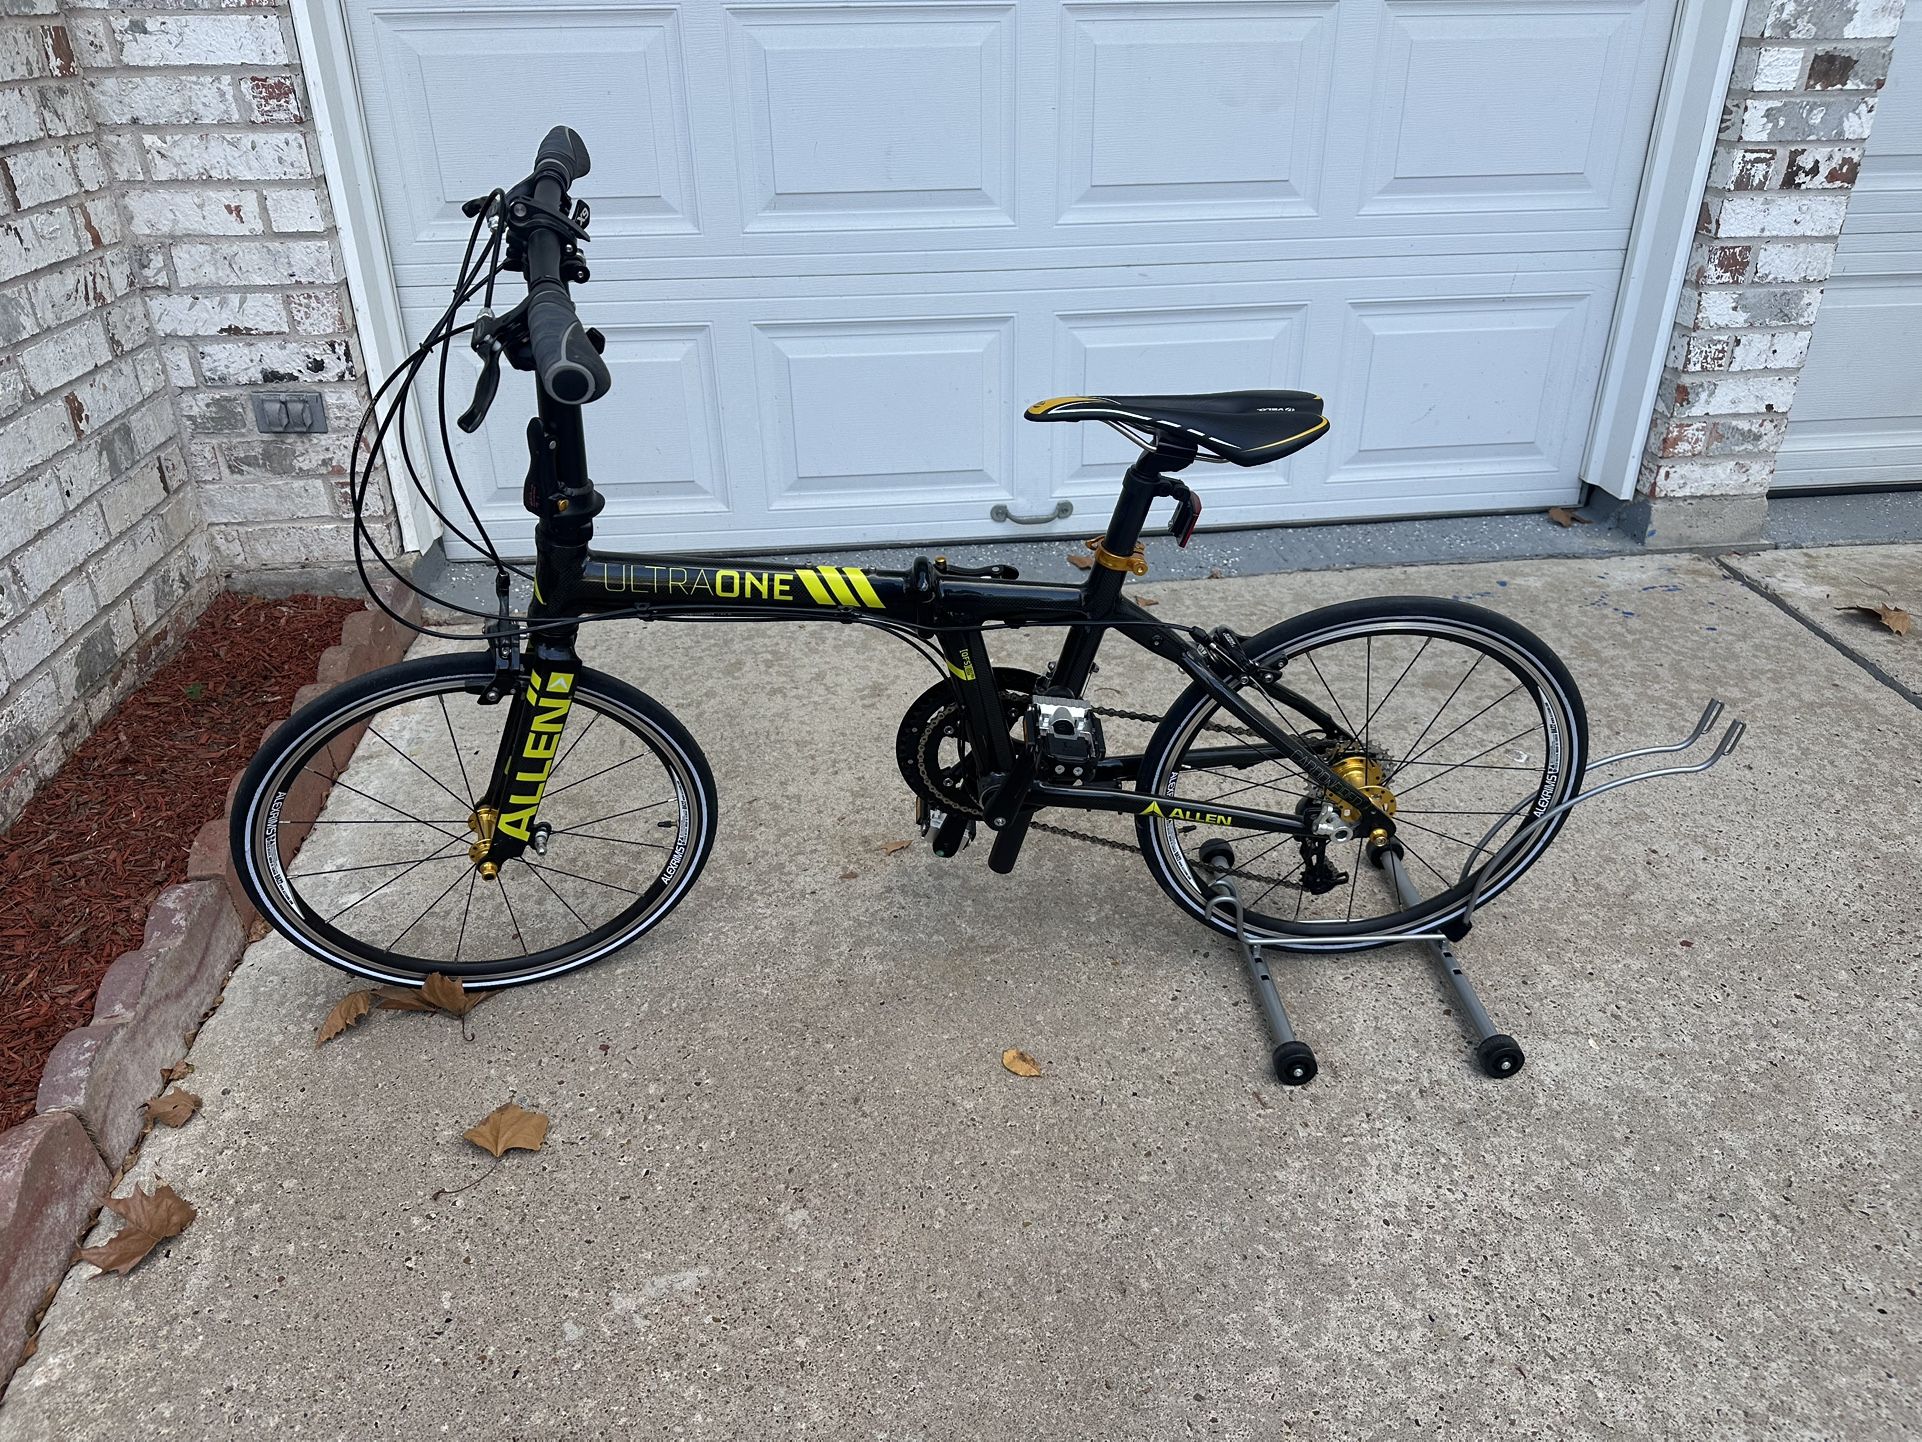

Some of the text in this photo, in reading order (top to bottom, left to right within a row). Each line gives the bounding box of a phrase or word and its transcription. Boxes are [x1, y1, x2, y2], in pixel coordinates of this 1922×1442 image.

[497, 697, 572, 842] ALLEN
[265, 791, 287, 836] ALEXRIMS
[1169, 808, 1232, 825] ALLEN
[1533, 774, 1557, 818] ALEXRIMS
[661, 845, 685, 885] ALEXRIMS
